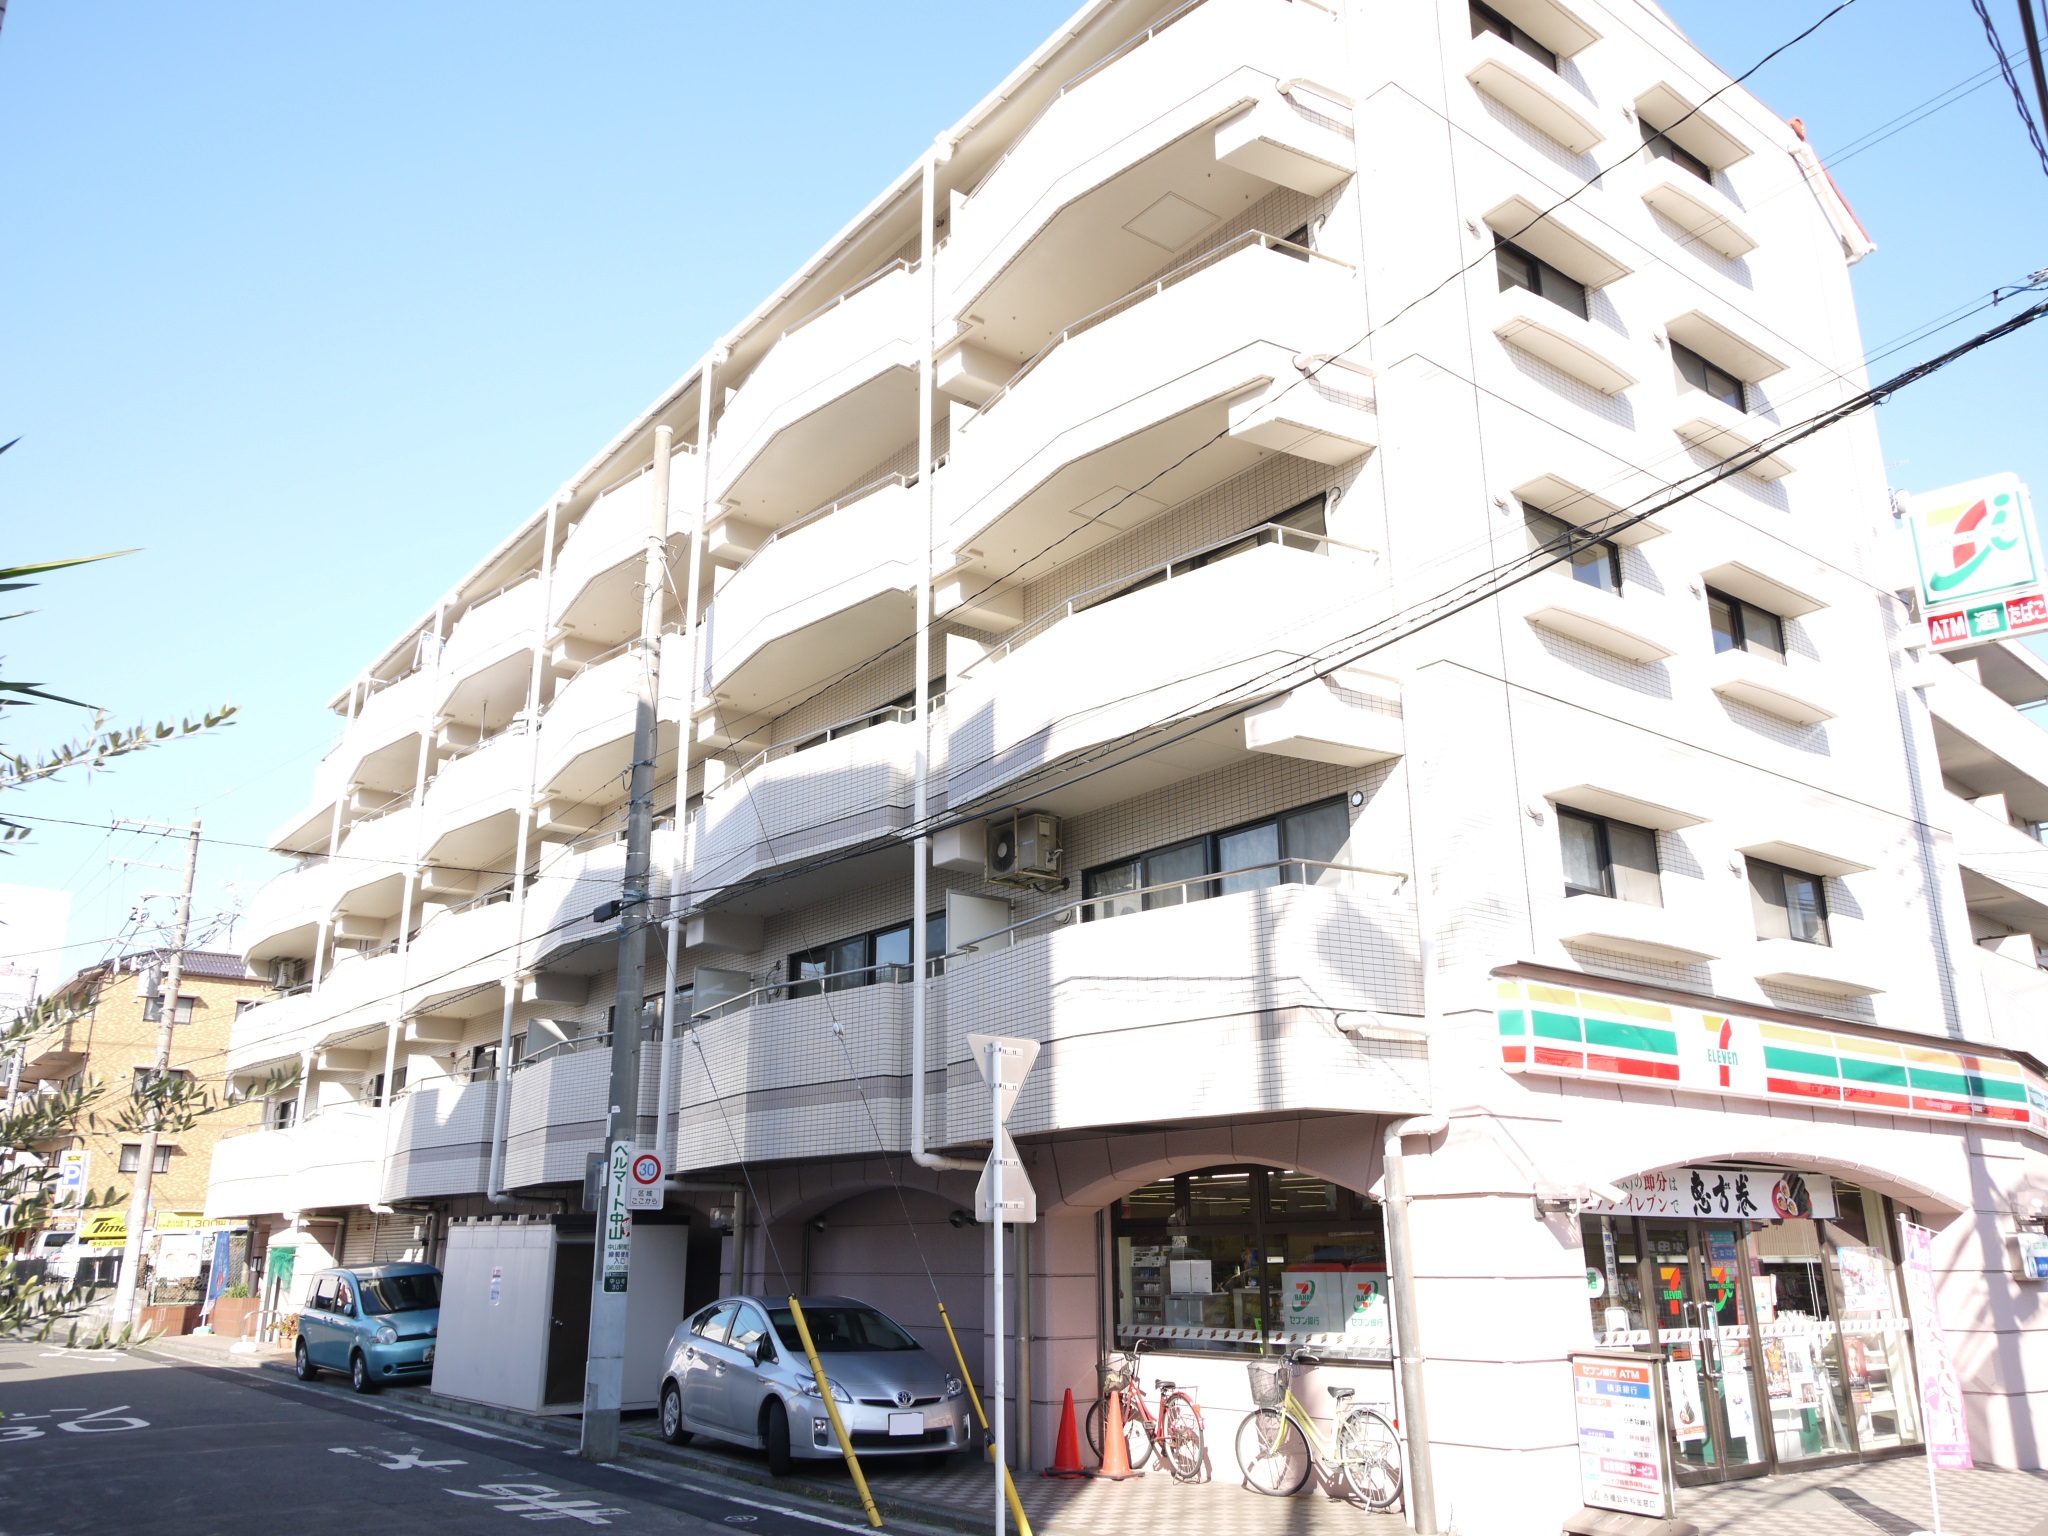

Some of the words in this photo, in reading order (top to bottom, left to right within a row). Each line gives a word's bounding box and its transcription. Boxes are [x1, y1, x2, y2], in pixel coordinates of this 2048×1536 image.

[2008, 599, 2047, 626] たばこ
[1932, 615, 1967, 641] ATM
[1974, 609, 2000, 633] 酒
[638, 1162, 655, 1177] 30
[608, 1144, 629, 1240] ベルマート中山
[638, 1189, 653, 1197] 区域
[631, 1197, 658, 1205] ここから
[92, 1216, 127, 1234] Time
[613, 1257, 625, 1265] 入口
[1289, 1315, 1320, 1326] セブン銀行
[1351, 1317, 1384, 1328] セブン銀行
[1582, 1365, 1617, 1378] セブン銀行
[1619, 1368, 1641, 1380] ATM
[1606, 1383, 1638, 1396] 横浜銀行
[1623, 1416, 1652, 1428] りそな銀行
